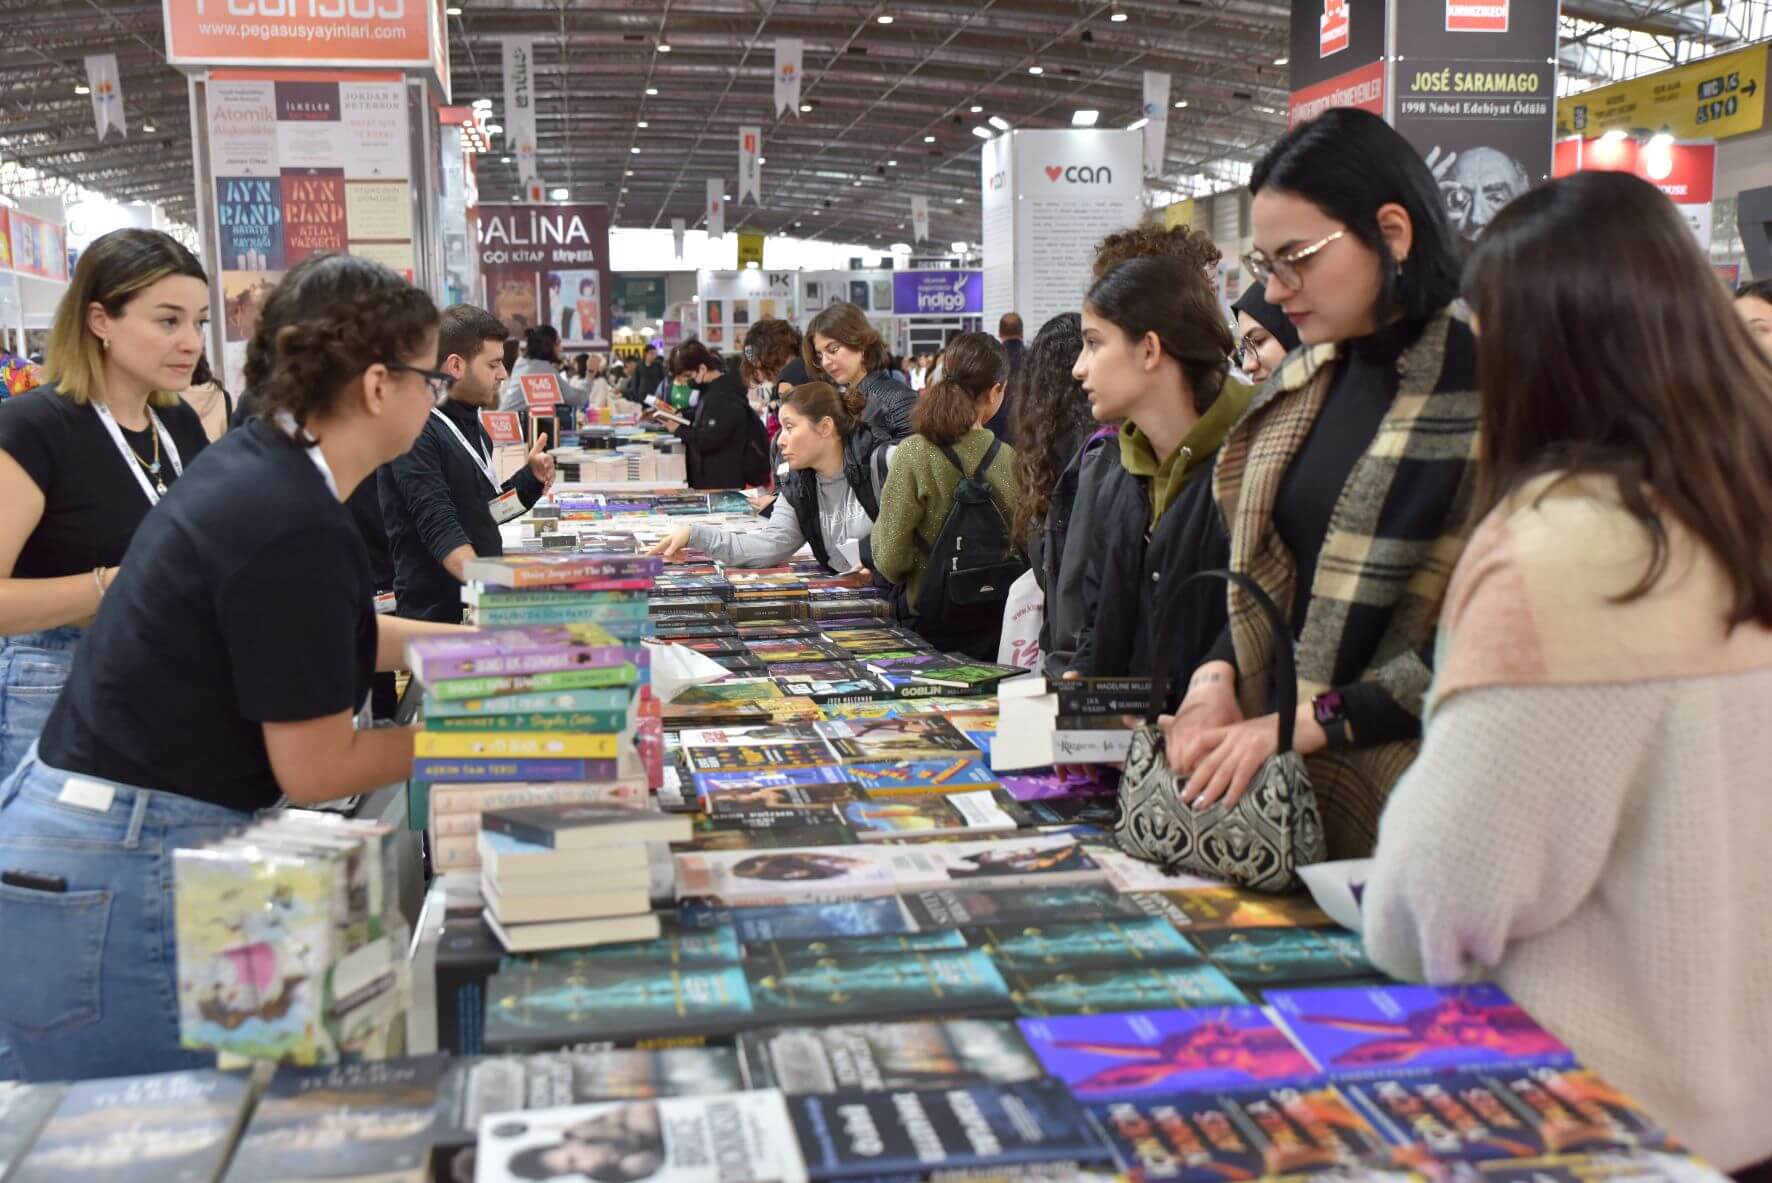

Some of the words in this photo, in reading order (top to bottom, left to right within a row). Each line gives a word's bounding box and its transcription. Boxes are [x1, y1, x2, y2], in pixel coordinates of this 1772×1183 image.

[199, 23, 406, 41] www.pegasusyayinlari.com
[1411, 68, 1451, 92] JOSÉ
[1454, 73, 1539, 93] SARAMAGO
[214, 105, 274, 121] Atomik
[1401, 102, 1426, 114] 1998
[1429, 102, 1460, 115] Nobel
[1463, 102, 1511, 117] Edebiyat
[1514, 101, 1547, 115] Ödülü
[1065, 165, 1112, 184] can
[227, 181, 271, 202] AYN
[293, 181, 335, 201] AYN
[220, 204, 280, 225] RAND
[286, 203, 344, 223] RAND
[902, 686, 942, 697] GOBLIN
